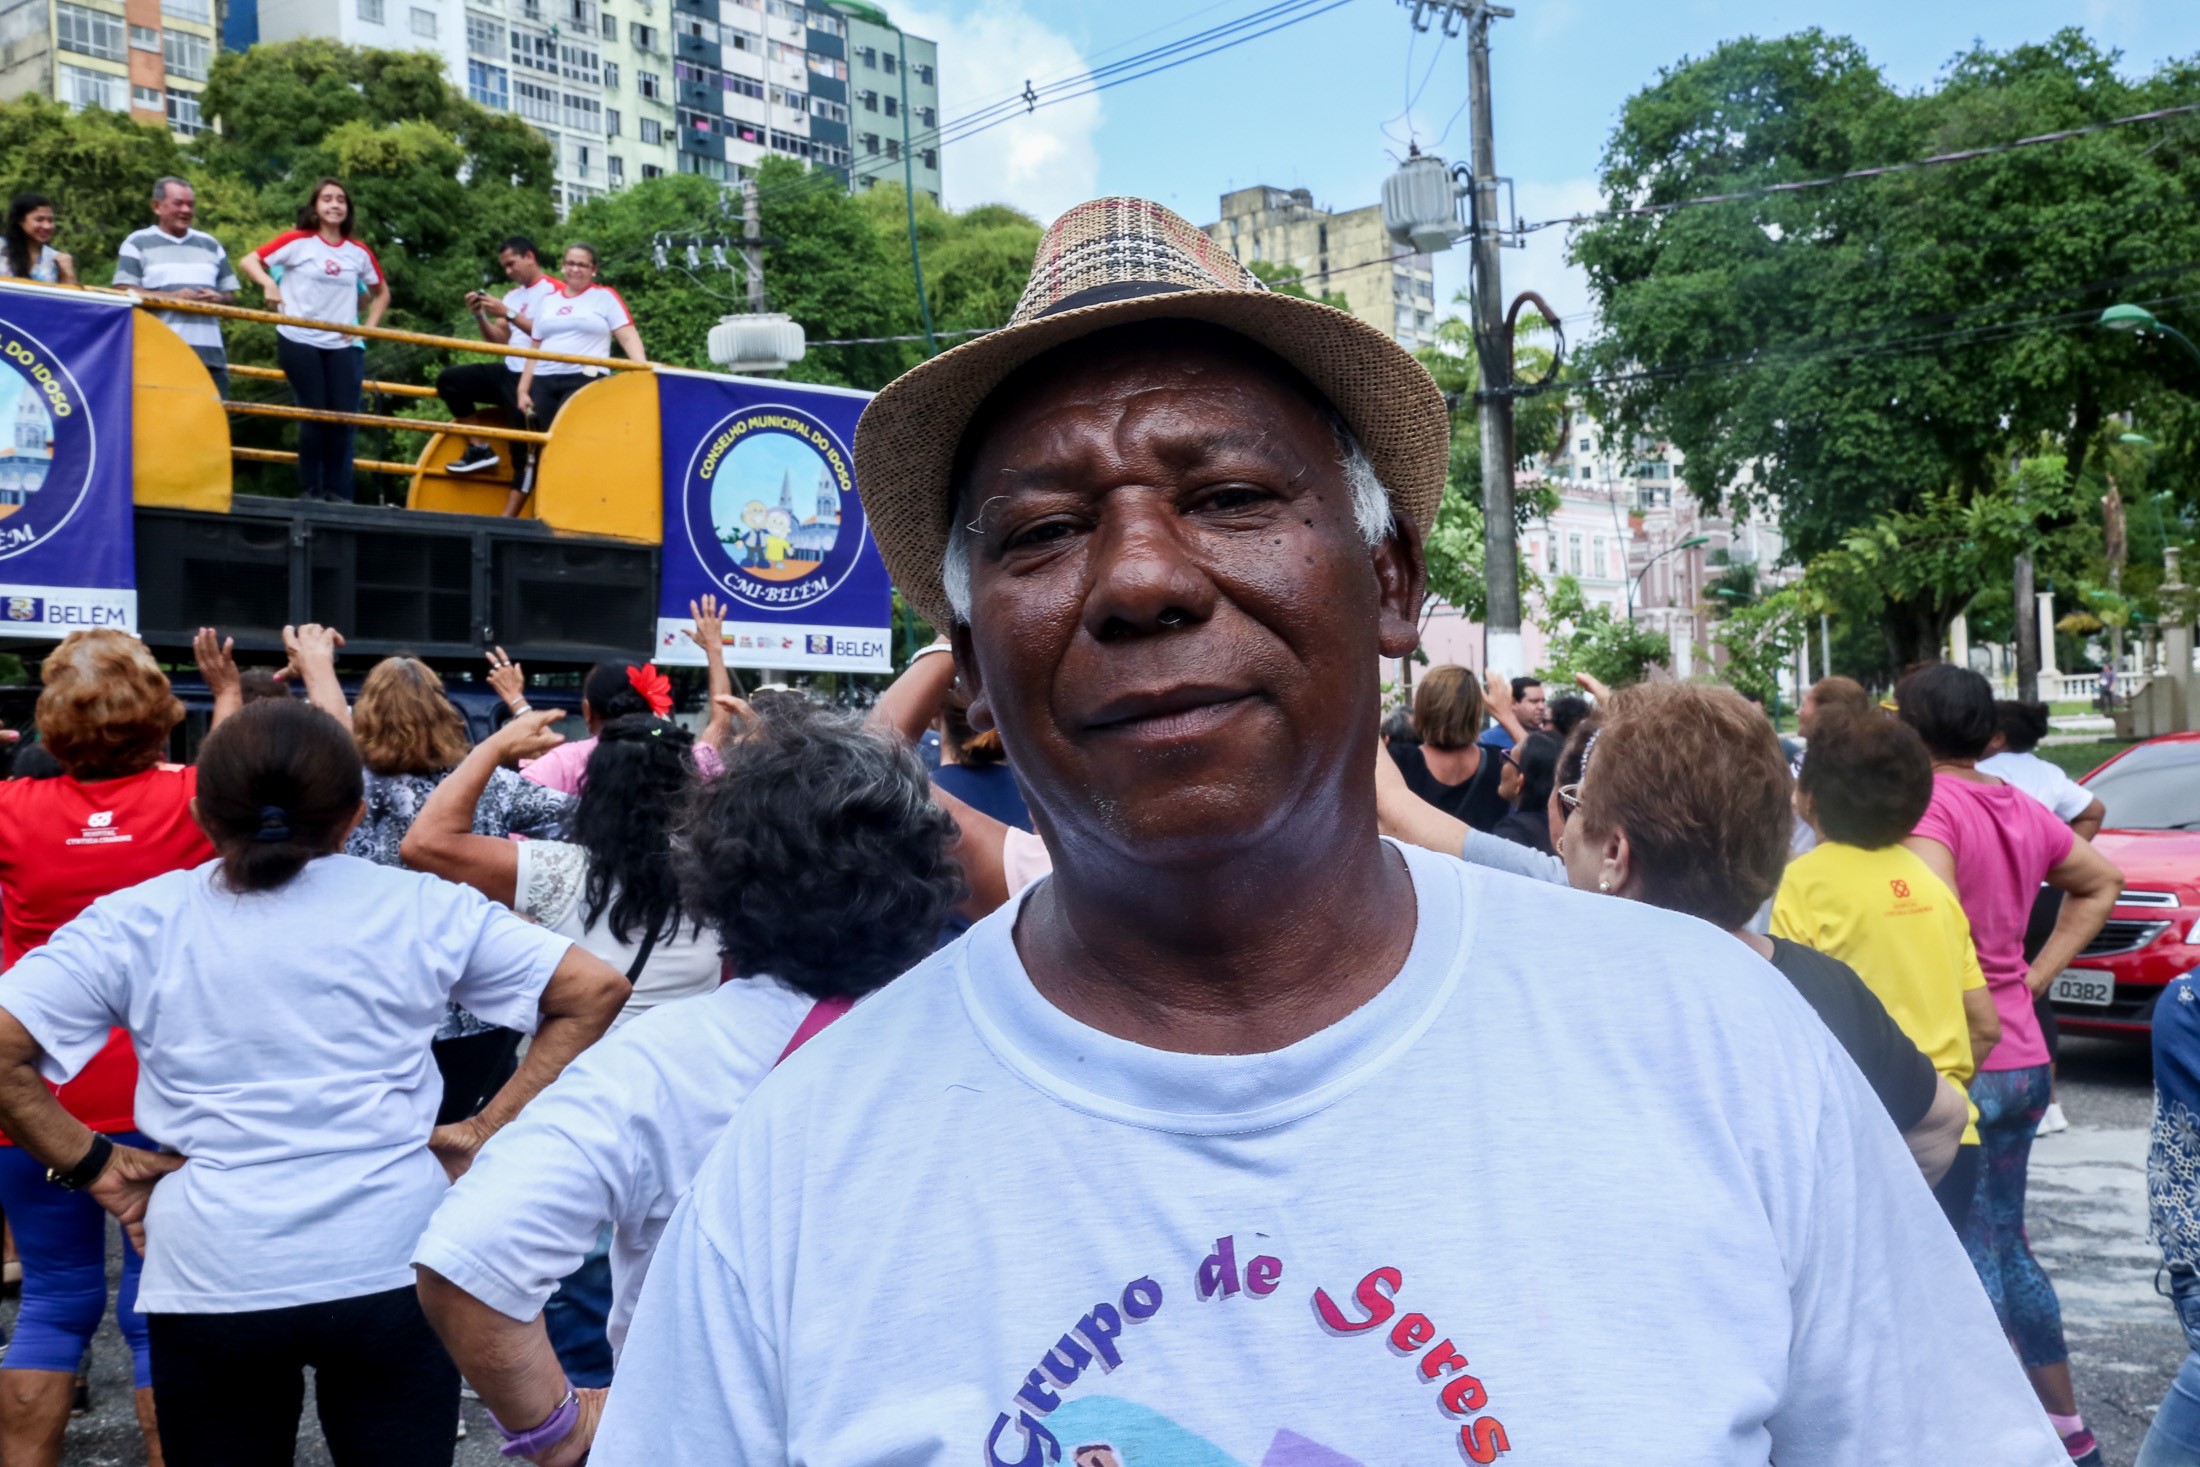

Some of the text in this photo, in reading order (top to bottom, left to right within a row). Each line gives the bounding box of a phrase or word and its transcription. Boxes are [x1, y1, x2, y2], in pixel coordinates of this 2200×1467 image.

[5, 341, 72, 417] DO IDOSO
[700, 415, 852, 491] CONSELHO MUNICIPAL DO IDOSO
[49, 604, 126, 626] BELÉM
[836, 640, 884, 658] BELÉM
[2059, 980, 2108, 1002] 0382
[984, 1234, 1512, 1467] Grupo de Seres
